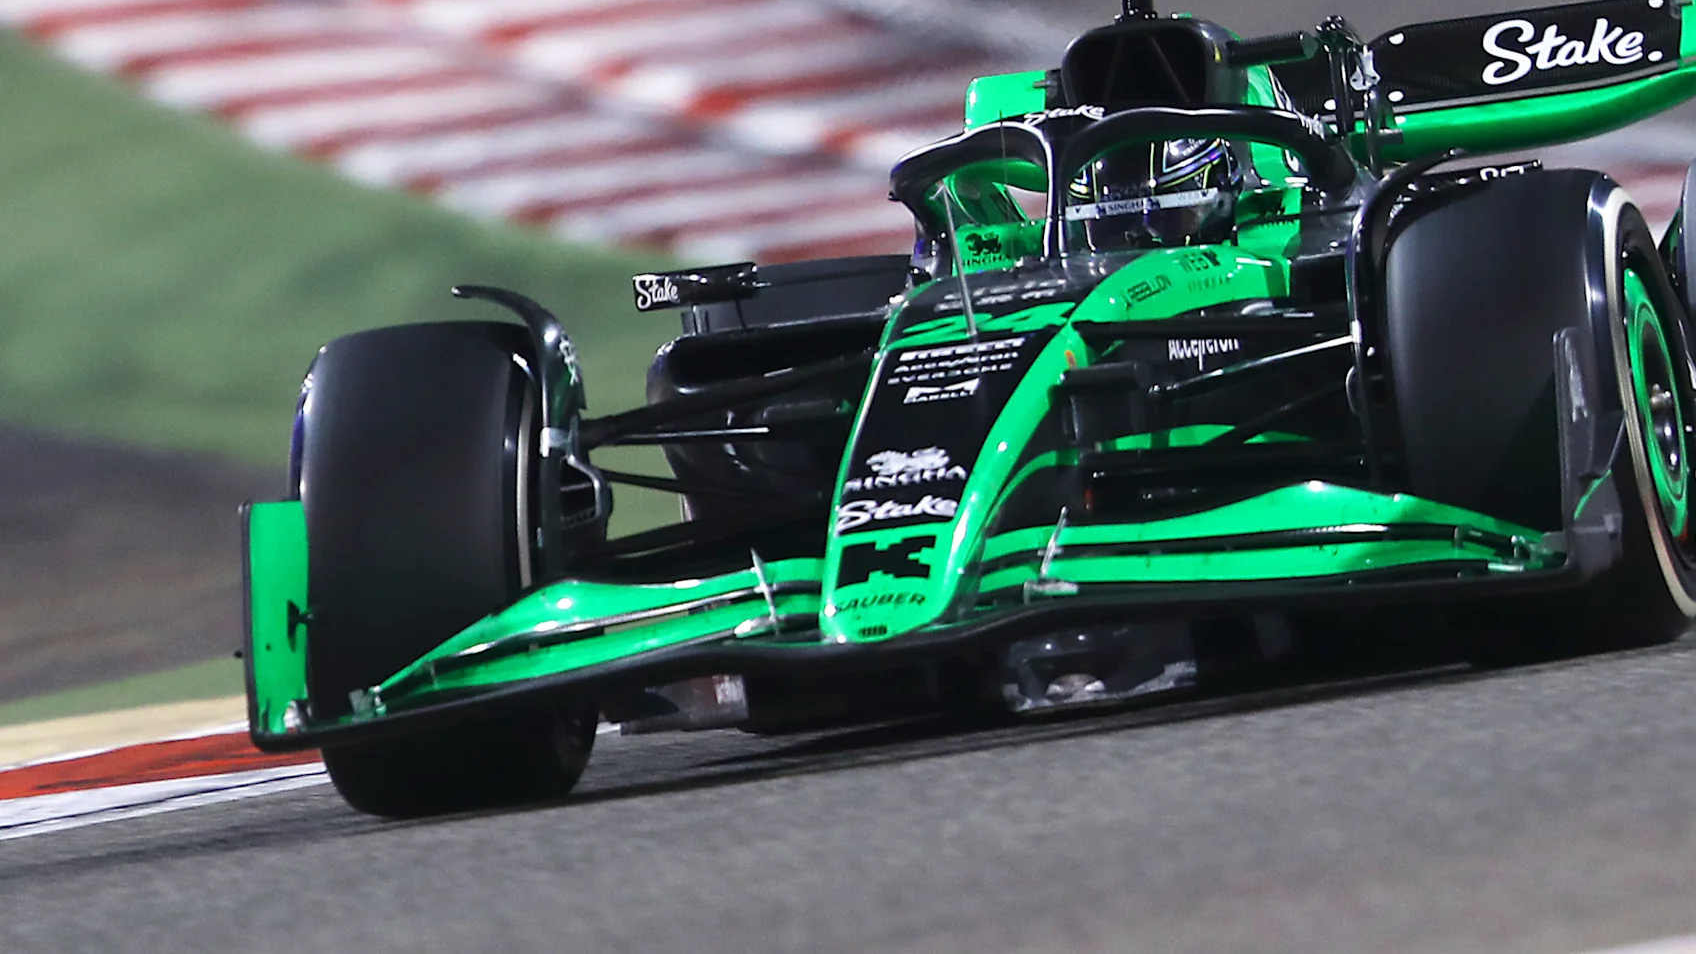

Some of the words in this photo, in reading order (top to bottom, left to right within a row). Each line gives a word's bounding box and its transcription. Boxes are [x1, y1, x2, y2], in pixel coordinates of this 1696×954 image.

[1482, 18, 1644, 85] Stake
[635, 276, 680, 309] Stake
[888, 301, 1072, 350] 24
[834, 495, 958, 538] Stake
